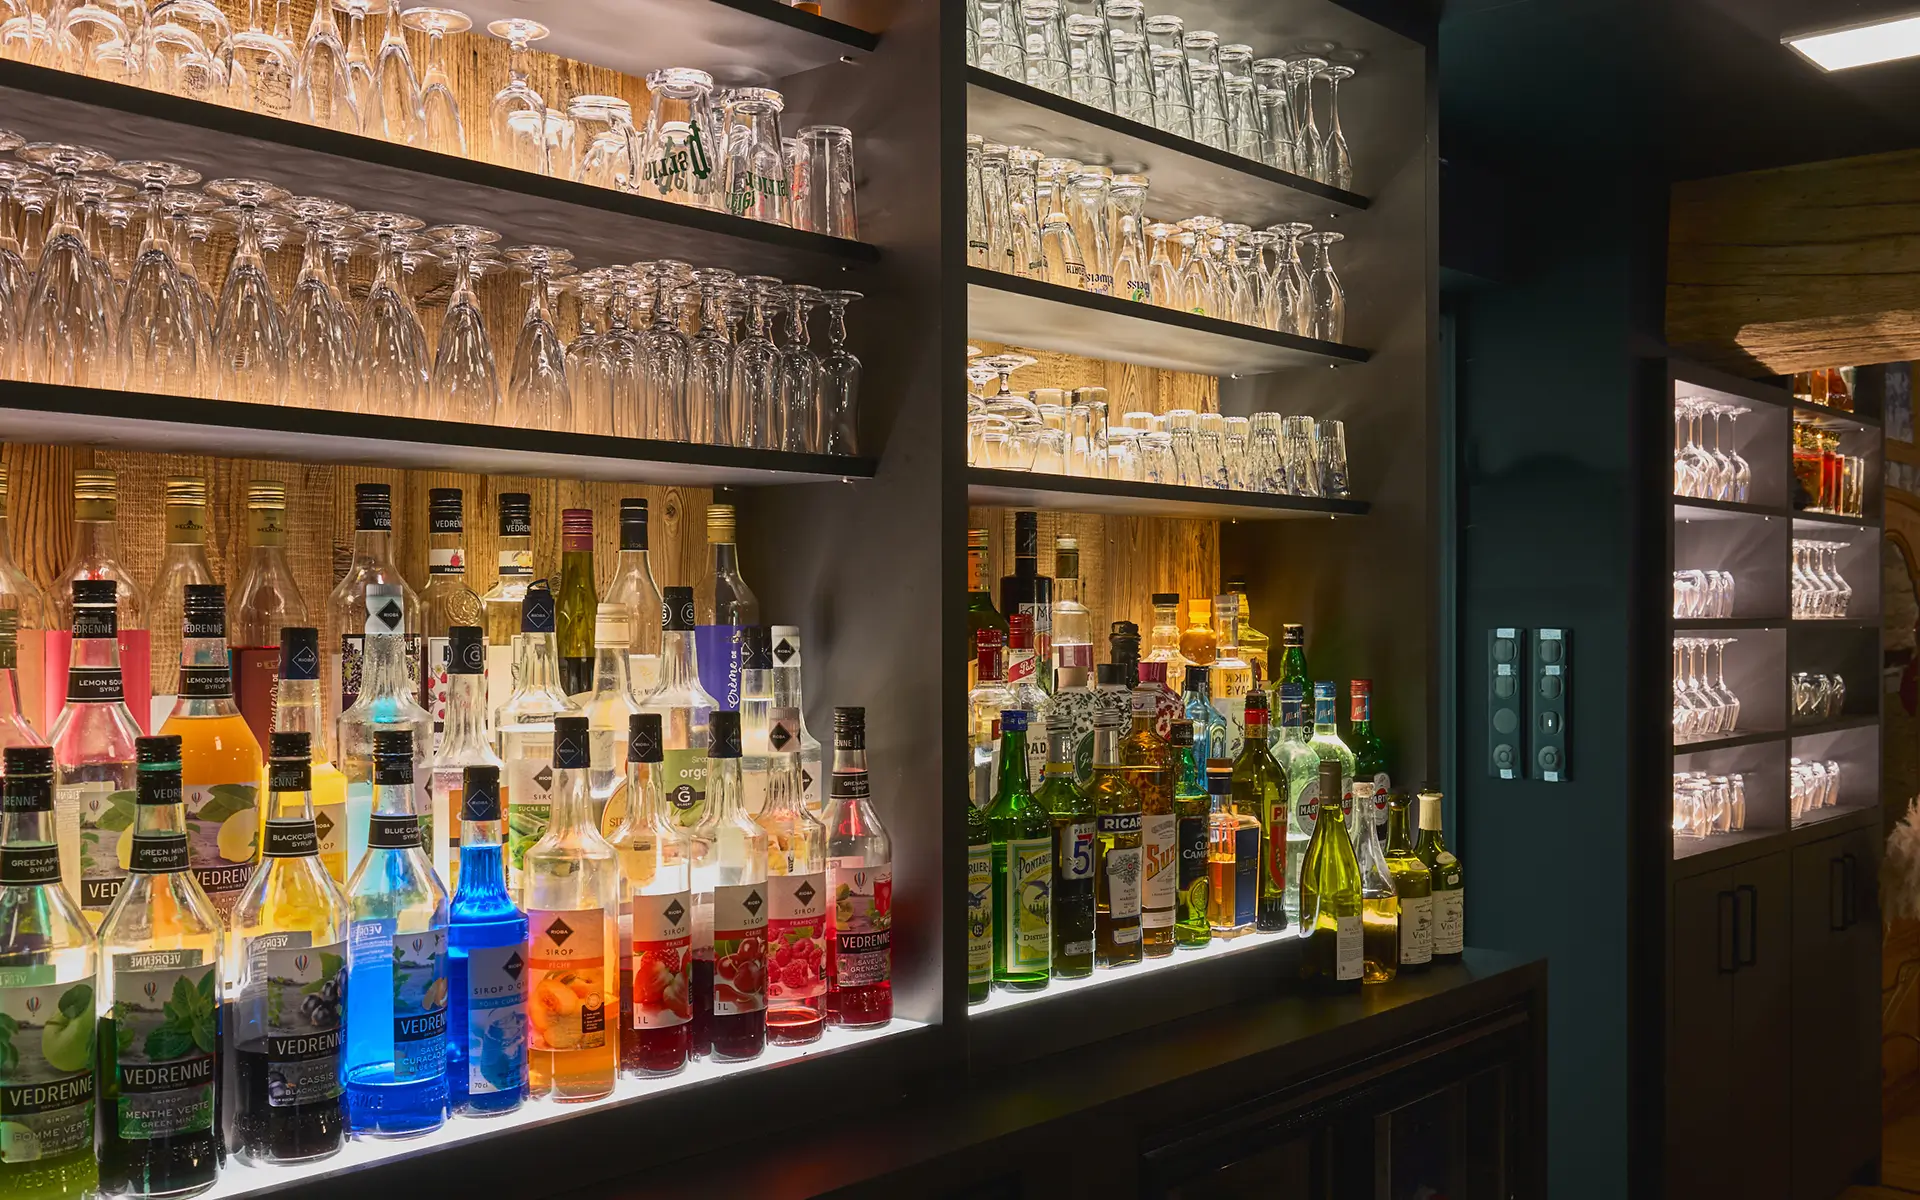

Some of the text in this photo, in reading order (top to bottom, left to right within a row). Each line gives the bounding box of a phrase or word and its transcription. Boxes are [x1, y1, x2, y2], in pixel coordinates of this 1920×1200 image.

[745, 170, 789, 199] errier
[79, 679, 107, 687] LEMON
[140, 849, 169, 857] GREEN
[11, 859, 43, 867] GREEN
[152, 856, 178, 864] SYRUP
[29, 866, 55, 874] SYRUP
[794, 907, 816, 915] SIROP
[743, 917, 763, 926] SIROP
[664, 927, 685, 936] SIROP
[841, 931, 890, 949] VEDRENNE
[474, 986, 504, 995] SIROP
[276, 1029, 347, 1055] VEDRENNE
[124, 1059, 210, 1085] VEDRENNE
[299, 1072, 334, 1086] CASSIS
[9, 1075, 93, 1107] VEDRENNE
[157, 1097, 181, 1105] SIROP
[126, 1101, 209, 1119] MENTHE VERTE
[46, 1115, 71, 1124] SIROP
[141, 1120, 173, 1128] GREEN
[14, 1128, 60, 1141] POMME
